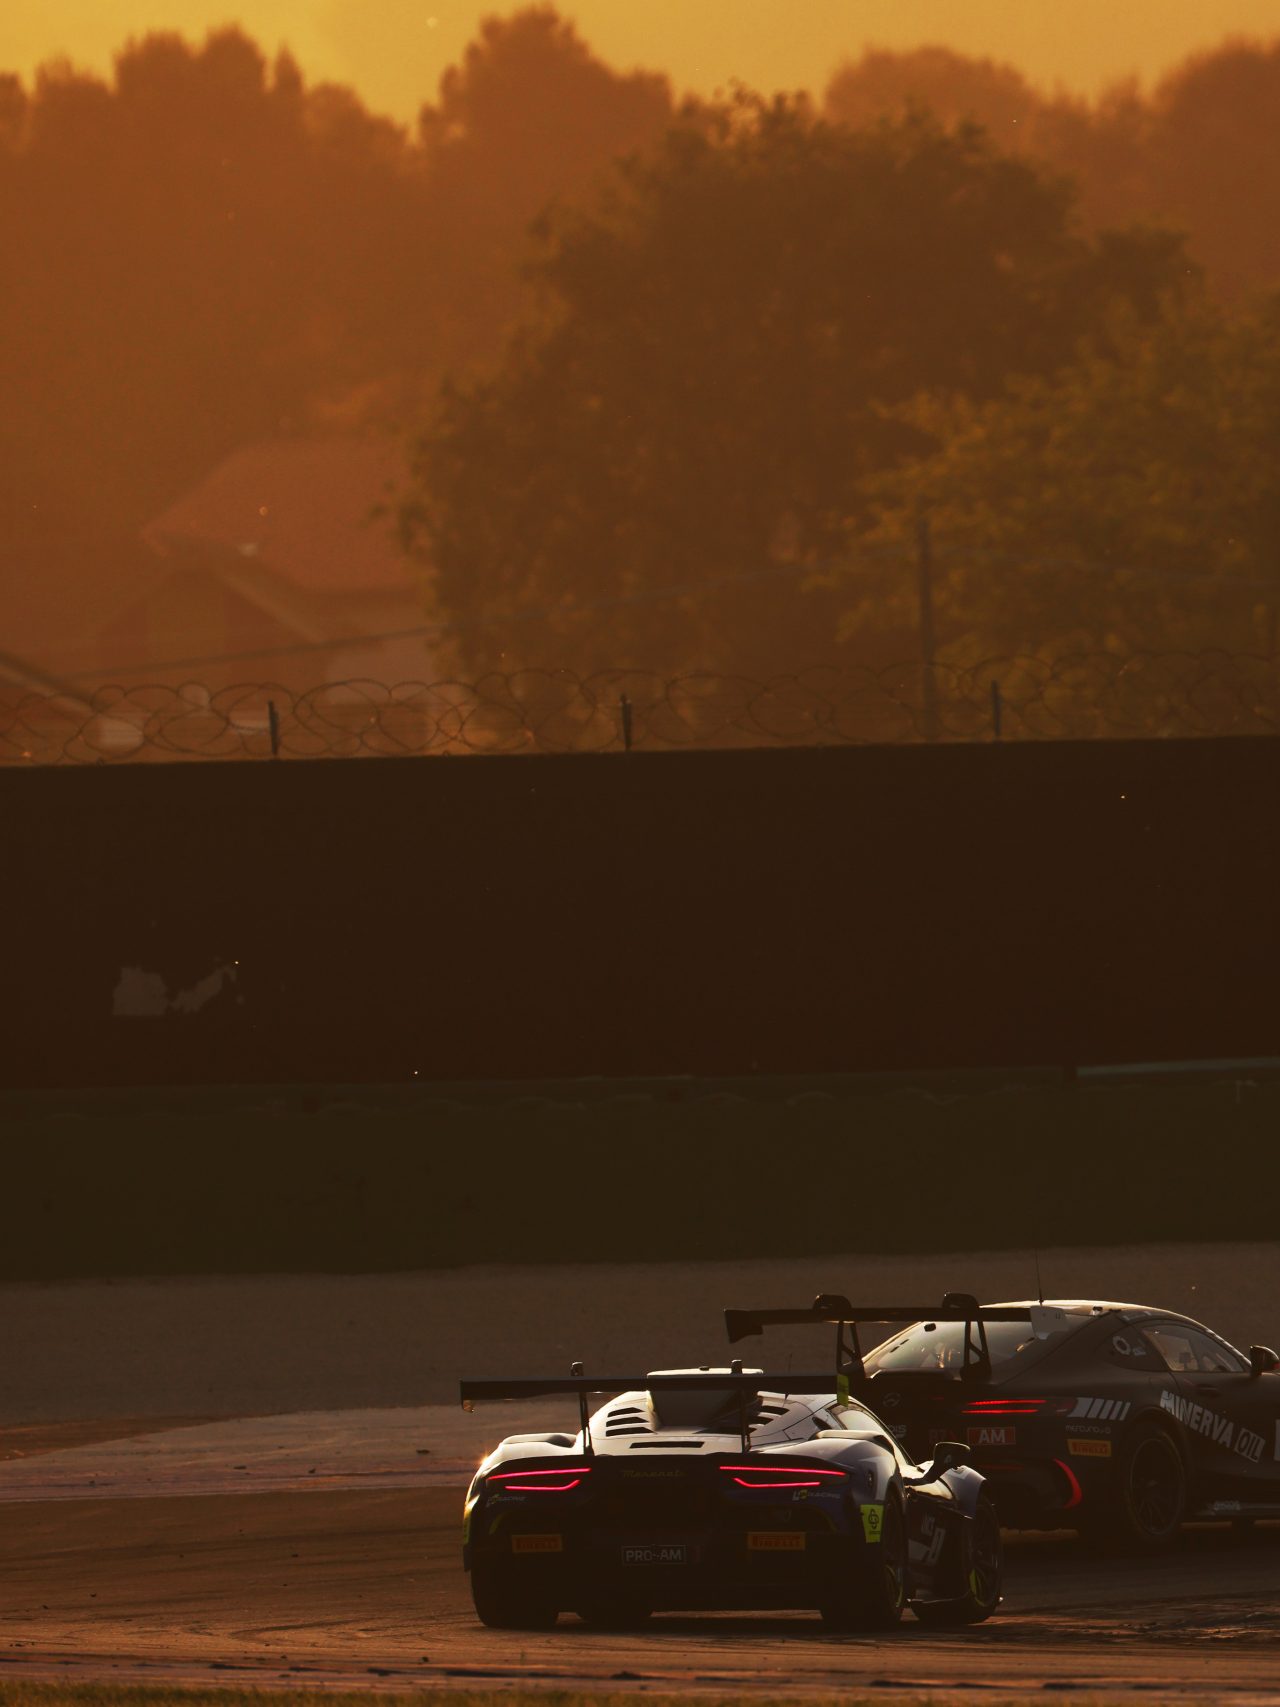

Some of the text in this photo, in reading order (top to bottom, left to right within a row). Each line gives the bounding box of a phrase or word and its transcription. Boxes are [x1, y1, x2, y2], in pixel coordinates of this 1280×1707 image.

[1160, 1390, 1266, 1461] MINERVA OIL
[978, 1427, 1006, 1443] AM
[625, 1549, 684, 1563] PRO-AM
